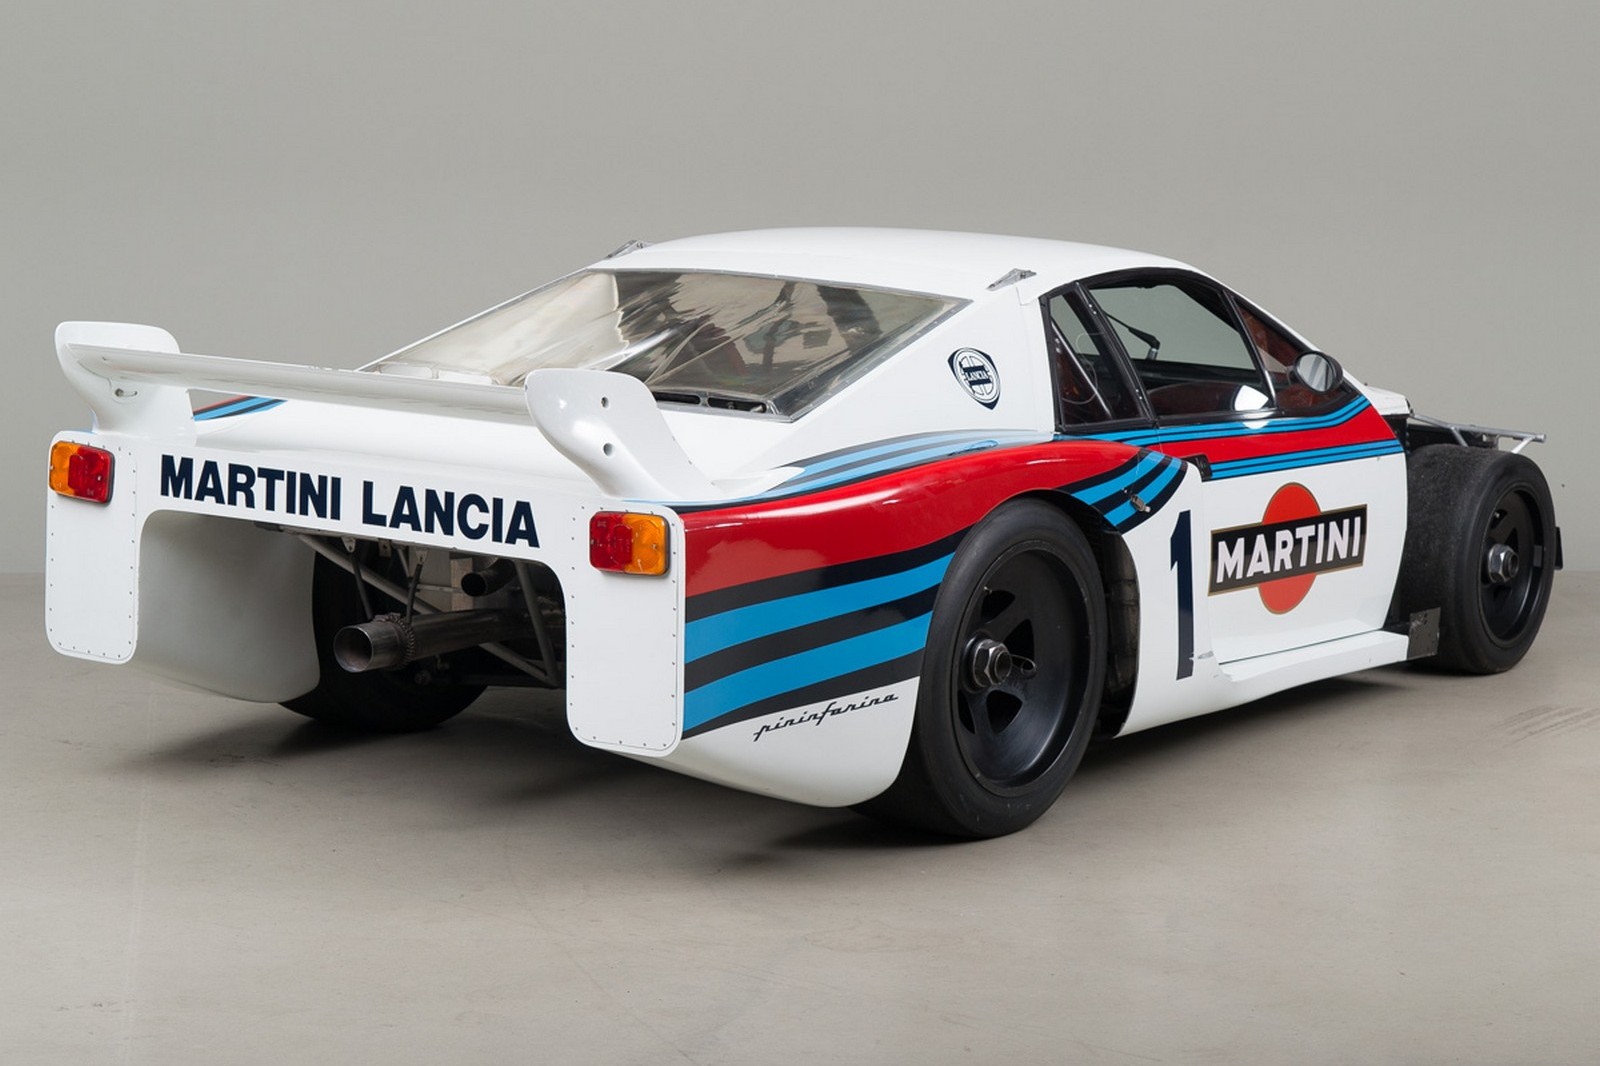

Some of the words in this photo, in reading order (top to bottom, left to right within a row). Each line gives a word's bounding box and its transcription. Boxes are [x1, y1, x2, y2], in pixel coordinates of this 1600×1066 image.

[964, 370, 989, 381] LANCIA
[160, 454, 341, 520] MARTINI
[362, 480, 540, 548] LANCIA
[1216, 516, 1361, 583] MARTINI
[1170, 509, 1194, 681] 1
[753, 692, 898, 742] pininfarina
